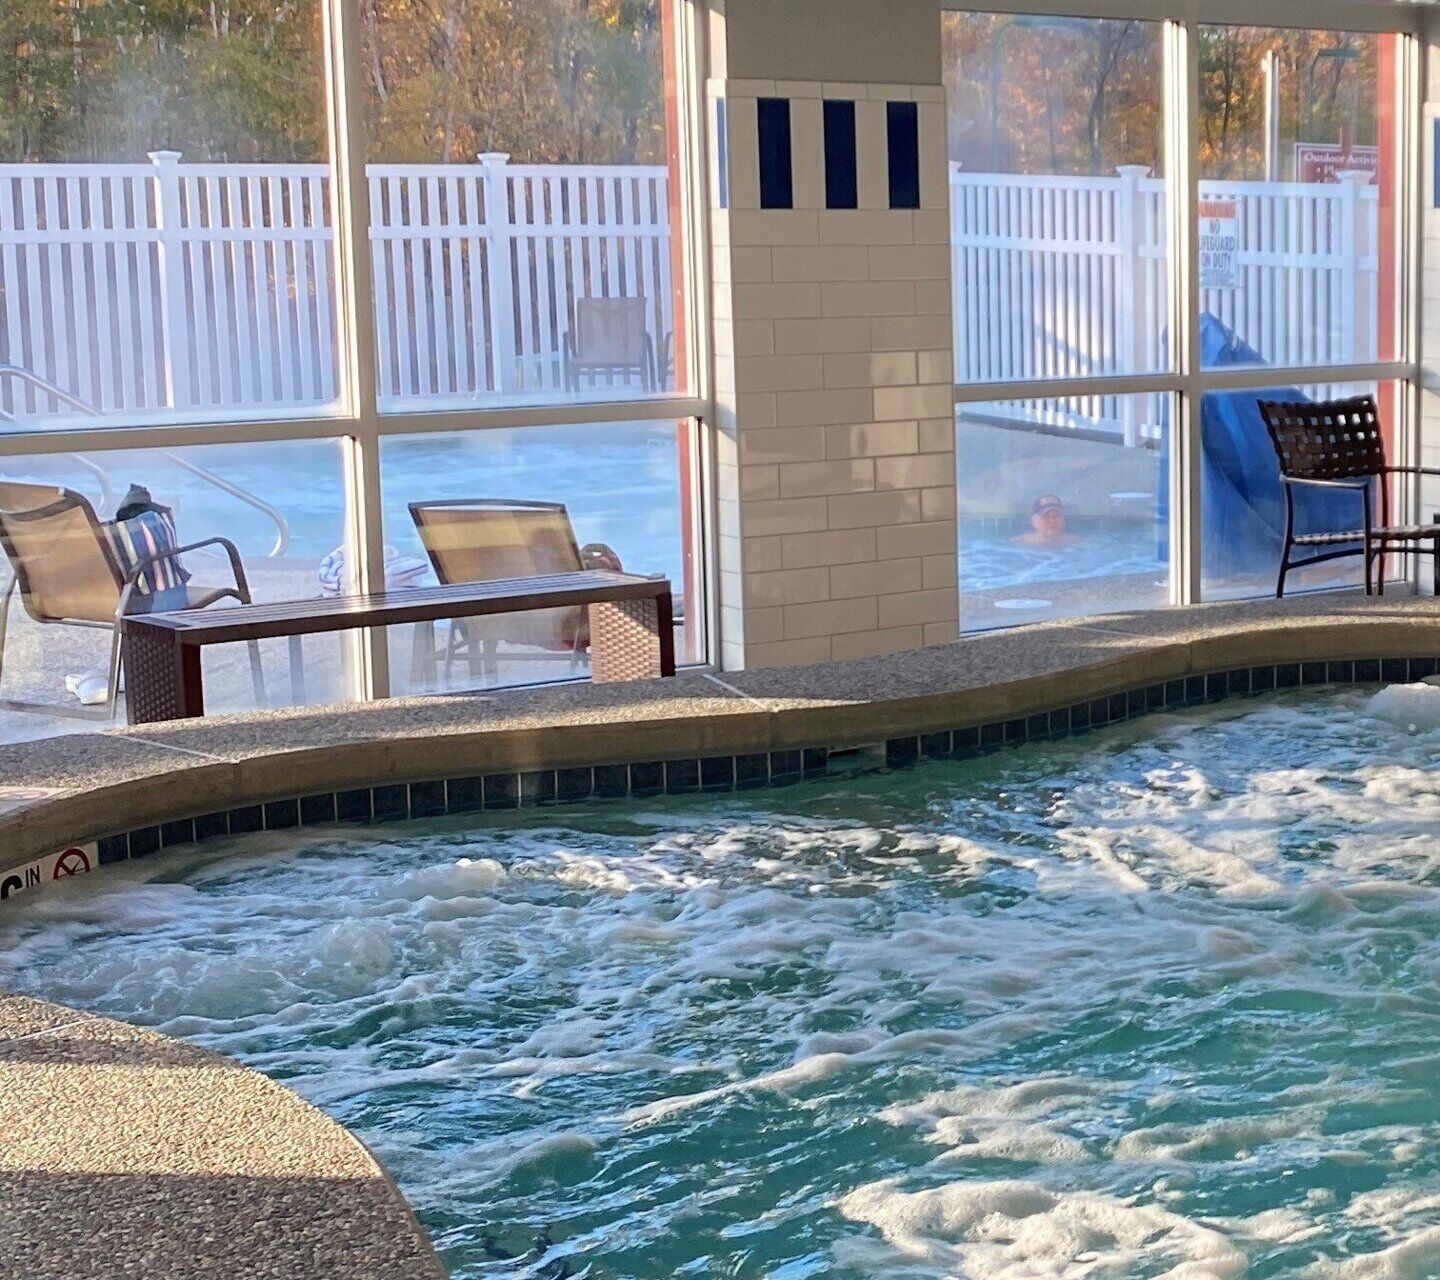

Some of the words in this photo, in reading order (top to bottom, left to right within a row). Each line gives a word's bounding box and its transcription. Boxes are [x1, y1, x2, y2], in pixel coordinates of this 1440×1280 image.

[1304, 151, 1345, 163] Outdoor
[1212, 251, 1232, 268] DUTY
[25, 864, 41, 888] IN
